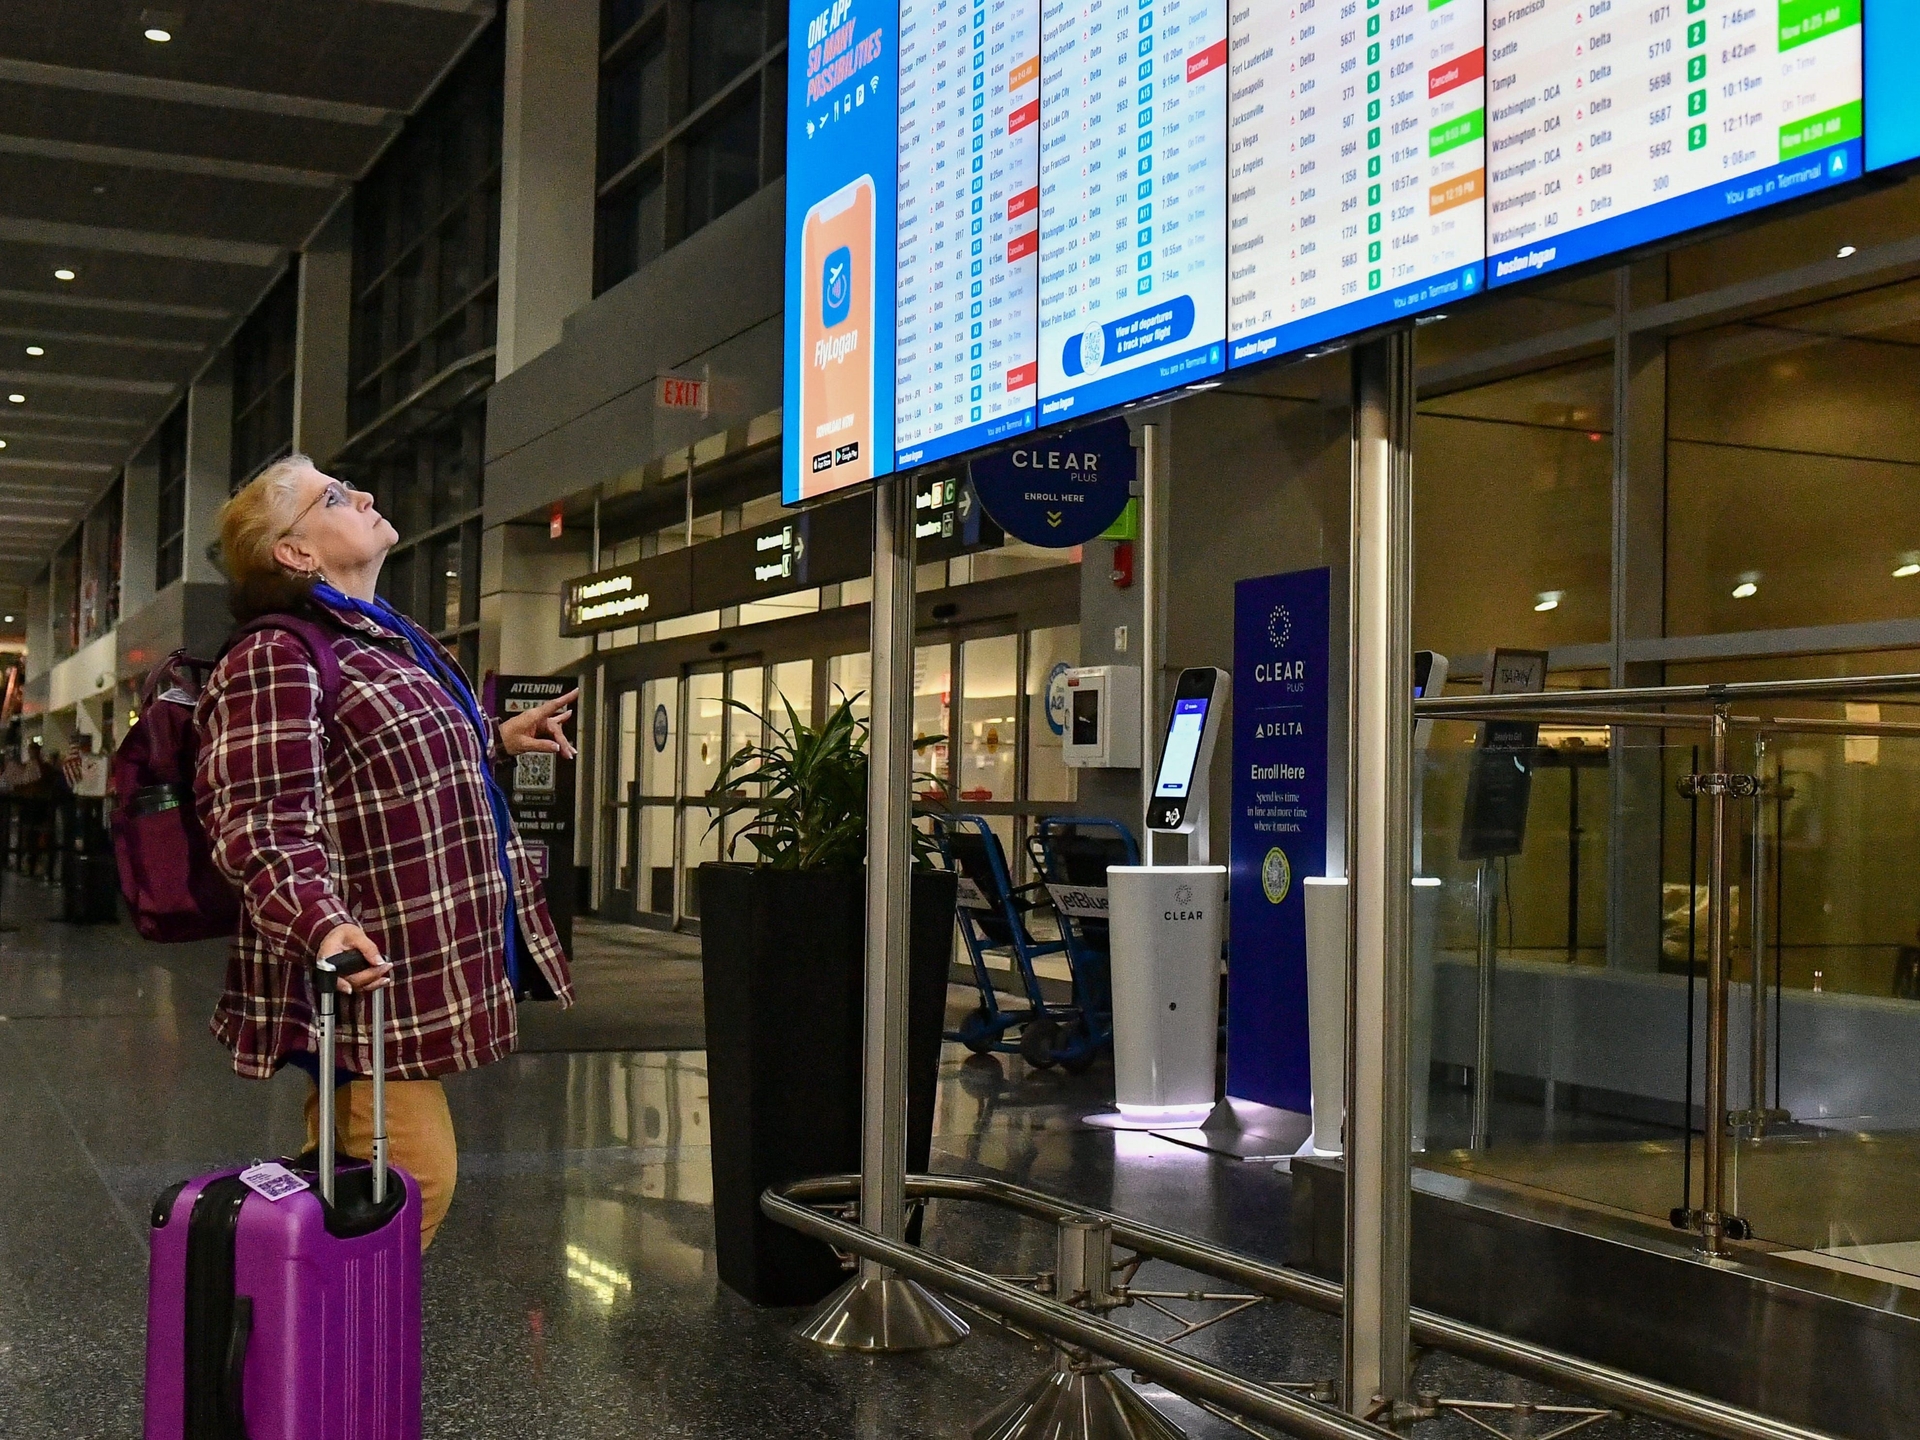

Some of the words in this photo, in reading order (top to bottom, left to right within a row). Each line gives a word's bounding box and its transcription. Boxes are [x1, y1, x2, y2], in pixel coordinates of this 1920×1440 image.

[808, 8, 829, 49] ONE
[829, 0, 852, 33] APP
[1493, 15, 1506, 30] San
[1508, 0, 1544, 21] Francisco
[1232, 62, 1243, 76] Fort
[1243, 47, 1273, 70] Lauderdale
[1341, 4, 1356, 19] 2685
[1493, 41, 1518, 61] Seattle
[1590, 1, 1611, 18] Delta
[807, 44, 822, 77] SO
[823, 16, 856, 66] MANY
[1232, 79, 1264, 102] Indianapolis
[1341, 32, 1356, 47] 5631
[1391, 5, 1413, 21] 8:24am
[1493, 74, 1516, 92] Tampa
[1590, 32, 1611, 50] Delta
[1650, 6, 1670, 25] 1071
[806, 28, 882, 107] POSSIBILITIES
[1493, 95, 1536, 122] Washington
[1544, 85, 1560, 101] DCA
[1590, 65, 1611, 82] Delta
[1650, 39, 1671, 58] 5710
[1723, 8, 1756, 29] 7:46am
[1232, 104, 1264, 127] Jacksonville
[1391, 33, 1413, 49] 9:01am
[1232, 140, 1241, 153] Las
[1243, 132, 1258, 150] Vegas
[1343, 86, 1354, 101] 373
[1391, 61, 1413, 79] 6:02am
[1493, 127, 1536, 152] Washington
[1544, 116, 1560, 133] DCA
[1590, 97, 1611, 115] Delta
[1650, 73, 1671, 92] 5698
[1722, 44, 1756, 63] 8:42am
[1232, 166, 1241, 179] Los
[1243, 158, 1263, 175] Angeles
[1343, 115, 1354, 129] 507
[1391, 91, 1414, 107] 5:30am
[1430, 67, 1458, 89] Cancelled
[1493, 157, 1536, 183] Washington
[1544, 148, 1560, 164] DCA
[1590, 131, 1611, 147] Delta
[1650, 106, 1671, 125] 5687
[1723, 76, 1762, 98] 10:19am
[1050, 154, 1070, 170] Francisco
[1493, 189, 1536, 213] Washington
[1545, 180, 1560, 196] DCA
[1591, 163, 1612, 180] Delta
[1650, 141, 1671, 159] 5692
[1723, 112, 1762, 133] 12:11pm
[1232, 216, 1248, 230] Miami
[1342, 170, 1356, 184] 1358
[1392, 146, 1418, 164] 10:19am
[1232, 185, 1255, 204] Memphis
[1725, 190, 1744, 204] You
[1747, 185, 1762, 199] are
[1765, 179, 1775, 192] in
[1778, 164, 1821, 188] Terminal
[1832, 156, 1843, 171] A
[1493, 221, 1536, 244] Washington
[1545, 212, 1558, 226] IAD
[1591, 196, 1612, 212] Delta
[1232, 234, 1264, 255] Minneapolis
[1232, 264, 1255, 281] Nashville
[1342, 225, 1356, 238] 1724
[1232, 290, 1255, 307] Nashville
[1392, 234, 1418, 249] 10:44am
[1041, 292, 1064, 307] Washington
[1068, 285, 1077, 297] DCA
[1394, 296, 1405, 308] You
[1407, 292, 1418, 304] are
[1420, 290, 1426, 301] in
[1428, 280, 1458, 298] Terminal
[1465, 273, 1473, 285] A
[1041, 317, 1050, 329] West
[1052, 312, 1062, 325] Palm
[1063, 308, 1076, 321] Beach
[1089, 300, 1100, 310] Delta
[1116, 325, 1130, 338] View
[1139, 310, 1172, 330] departures
[1232, 321, 1242, 332] New
[1245, 315, 1255, 328] York
[1262, 310, 1272, 322] JFK
[814, 328, 858, 371] FlyLogan
[1117, 343, 1122, 353] &
[1123, 338, 1138, 352] track
[1139, 334, 1153, 350] your
[1154, 325, 1171, 342] flight
[665, 380, 701, 406] EXIT
[1012, 450, 1098, 471] CLEAR
[946, 483, 953, 500] C
[1071, 473, 1097, 482] PLUS
[1024, 492, 1058, 501] ENROLL
[1062, 494, 1084, 502] HERE
[1255, 660, 1304, 682] CLEAR
[511, 683, 564, 694] ATTENTION
[1287, 683, 1304, 692] PLUS
[1267, 722, 1303, 736] DELTA
[1252, 764, 1278, 780] Enroll
[1280, 764, 1305, 780] Here
[1247, 806, 1253, 816] in
[1254, 806, 1266, 816] line
[1294, 807, 1307, 818] time
[1256, 791, 1274, 804] Spend
[1285, 792, 1299, 802] time
[1254, 821, 1271, 832] where
[1058, 892, 1108, 910] jetBlue
[1164, 910, 1203, 921] CLEAR
